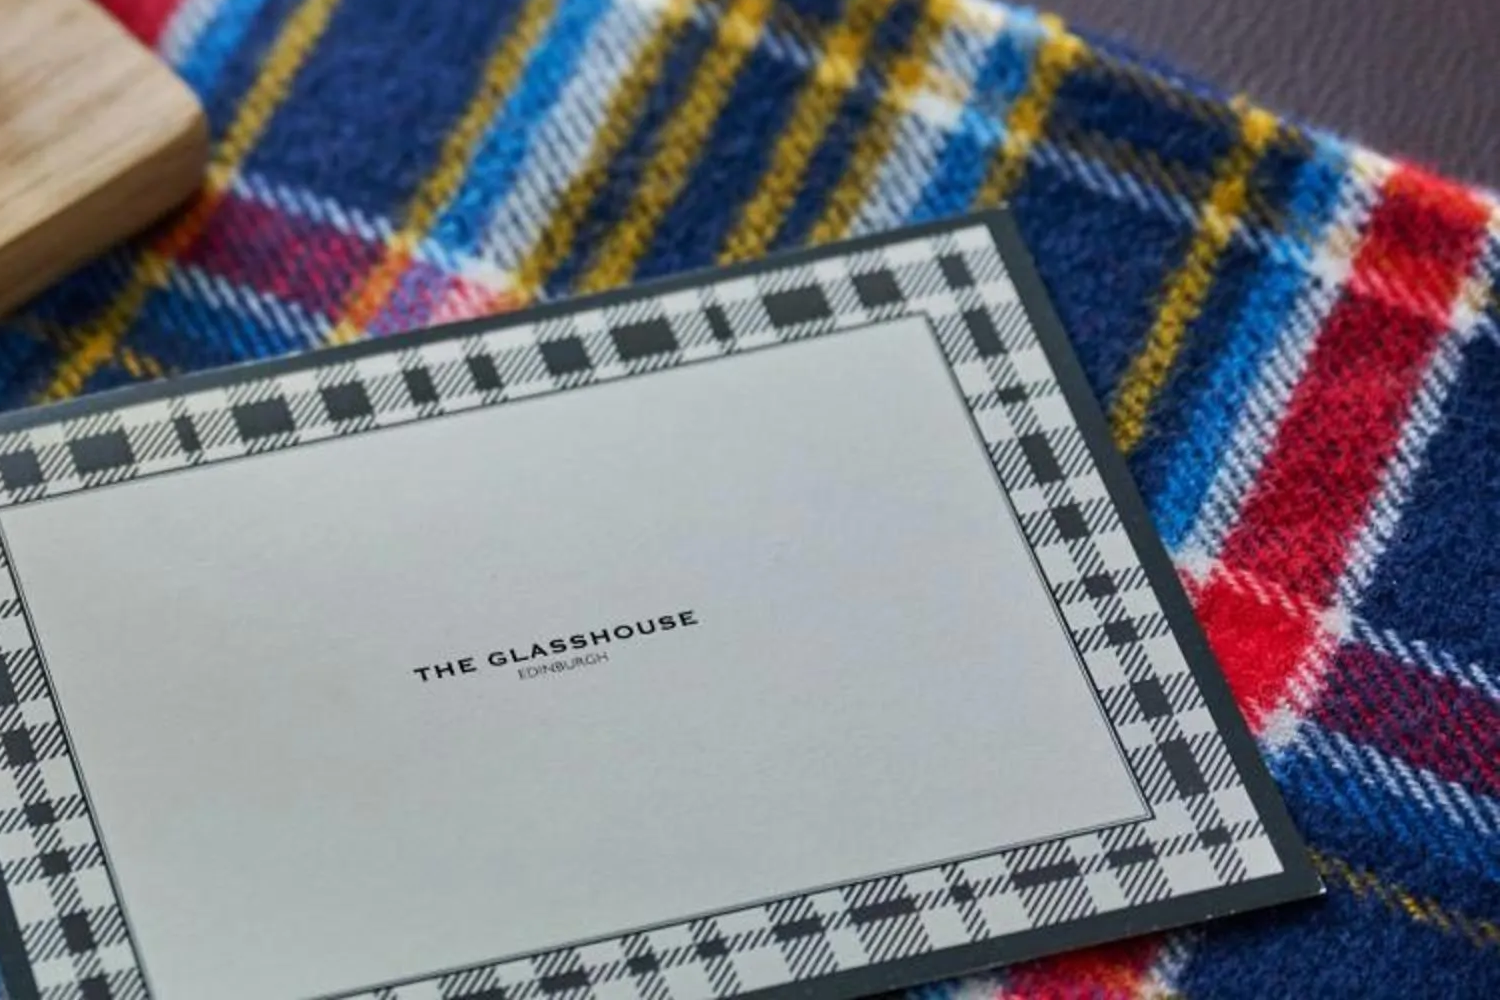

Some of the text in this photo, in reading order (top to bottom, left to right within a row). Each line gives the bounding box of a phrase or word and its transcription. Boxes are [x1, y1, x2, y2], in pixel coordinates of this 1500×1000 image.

[412, 609, 699, 683] THE GLASSHOUSE
[517, 651, 610, 681] EDINBURGH
